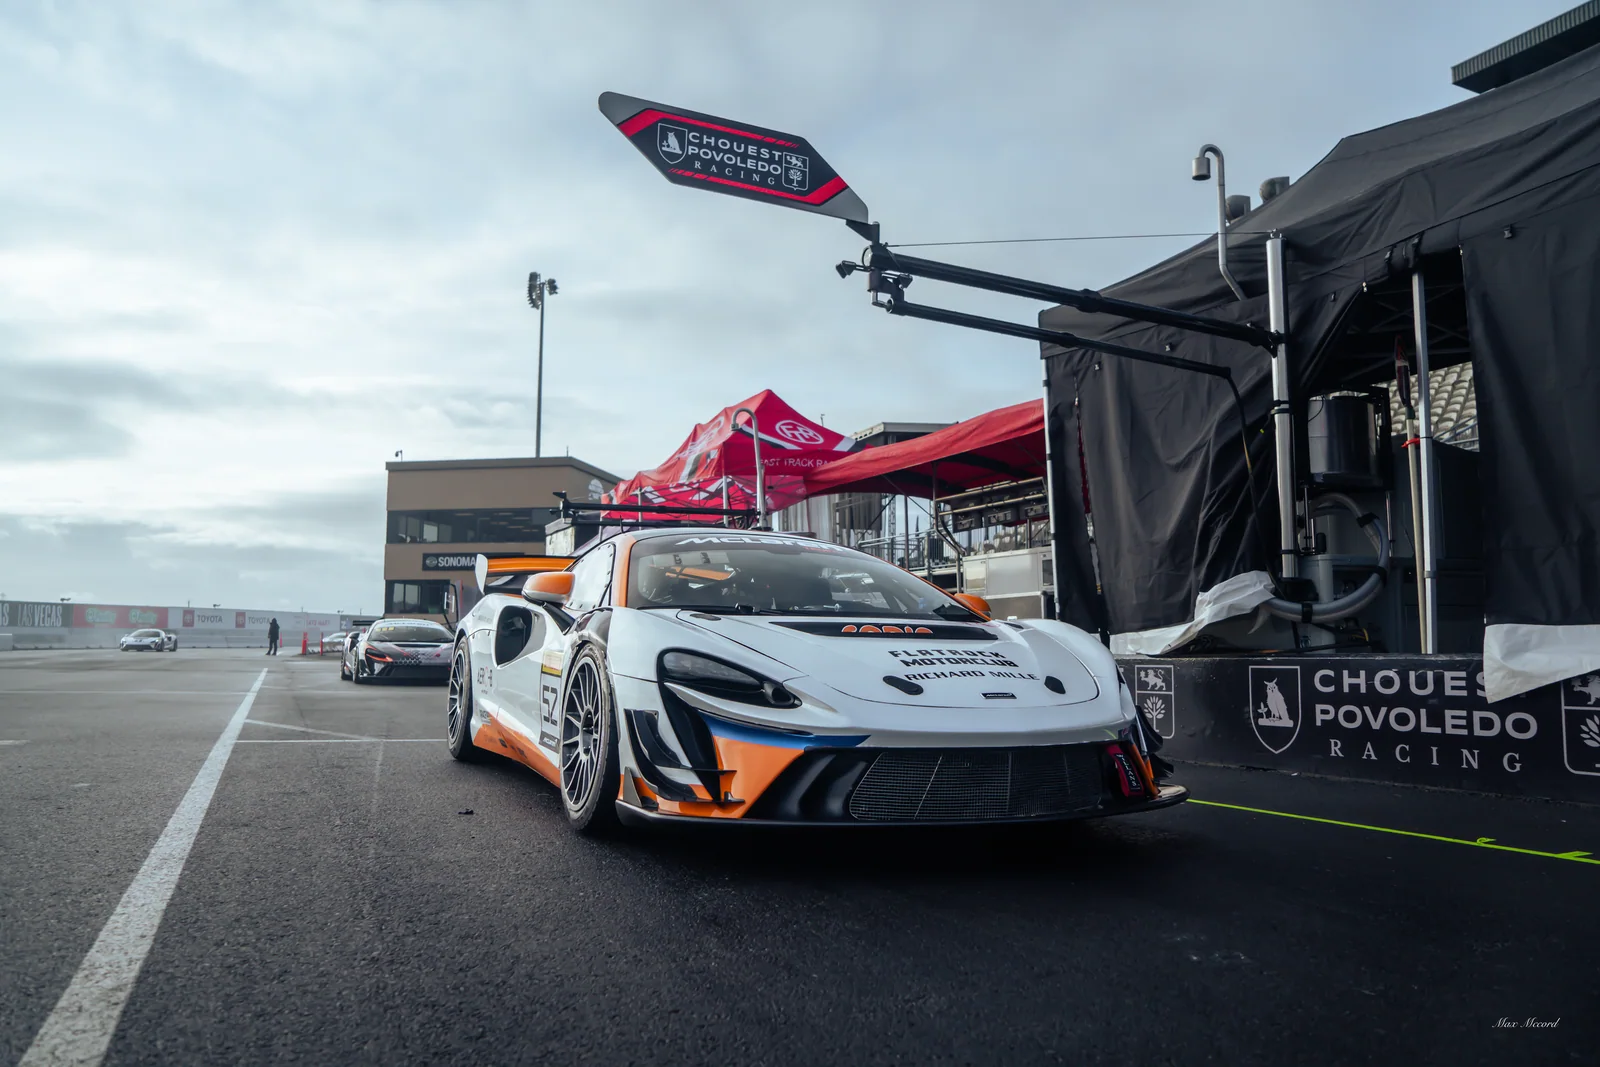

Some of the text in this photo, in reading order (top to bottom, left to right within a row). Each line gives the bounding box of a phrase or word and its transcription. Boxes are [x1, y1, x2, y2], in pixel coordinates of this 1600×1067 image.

[688, 132, 782, 161] CHOUEST
[687, 145, 782, 175] POVOLEDO
[694, 160, 776, 185] RACING
[784, 458, 814, 467] TRACK
[438, 556, 476, 567] SONOMA
[18, 604, 33, 626] LAS
[34, 604, 62, 627] VEGAS
[197, 614, 223, 624] TOYOTA
[248, 616, 270, 625] TOYOTA
[888, 649, 1006, 658] FLATROCK
[900, 658, 1018, 667] MOTORCLUB
[904, 670, 1040, 681] RICHARD MILLE
[1313, 668, 1486, 698] CHOUE
[543, 684, 558, 726] 52
[1315, 704, 1538, 740] POVOLEDO
[1329, 739, 1523, 773] RACING
